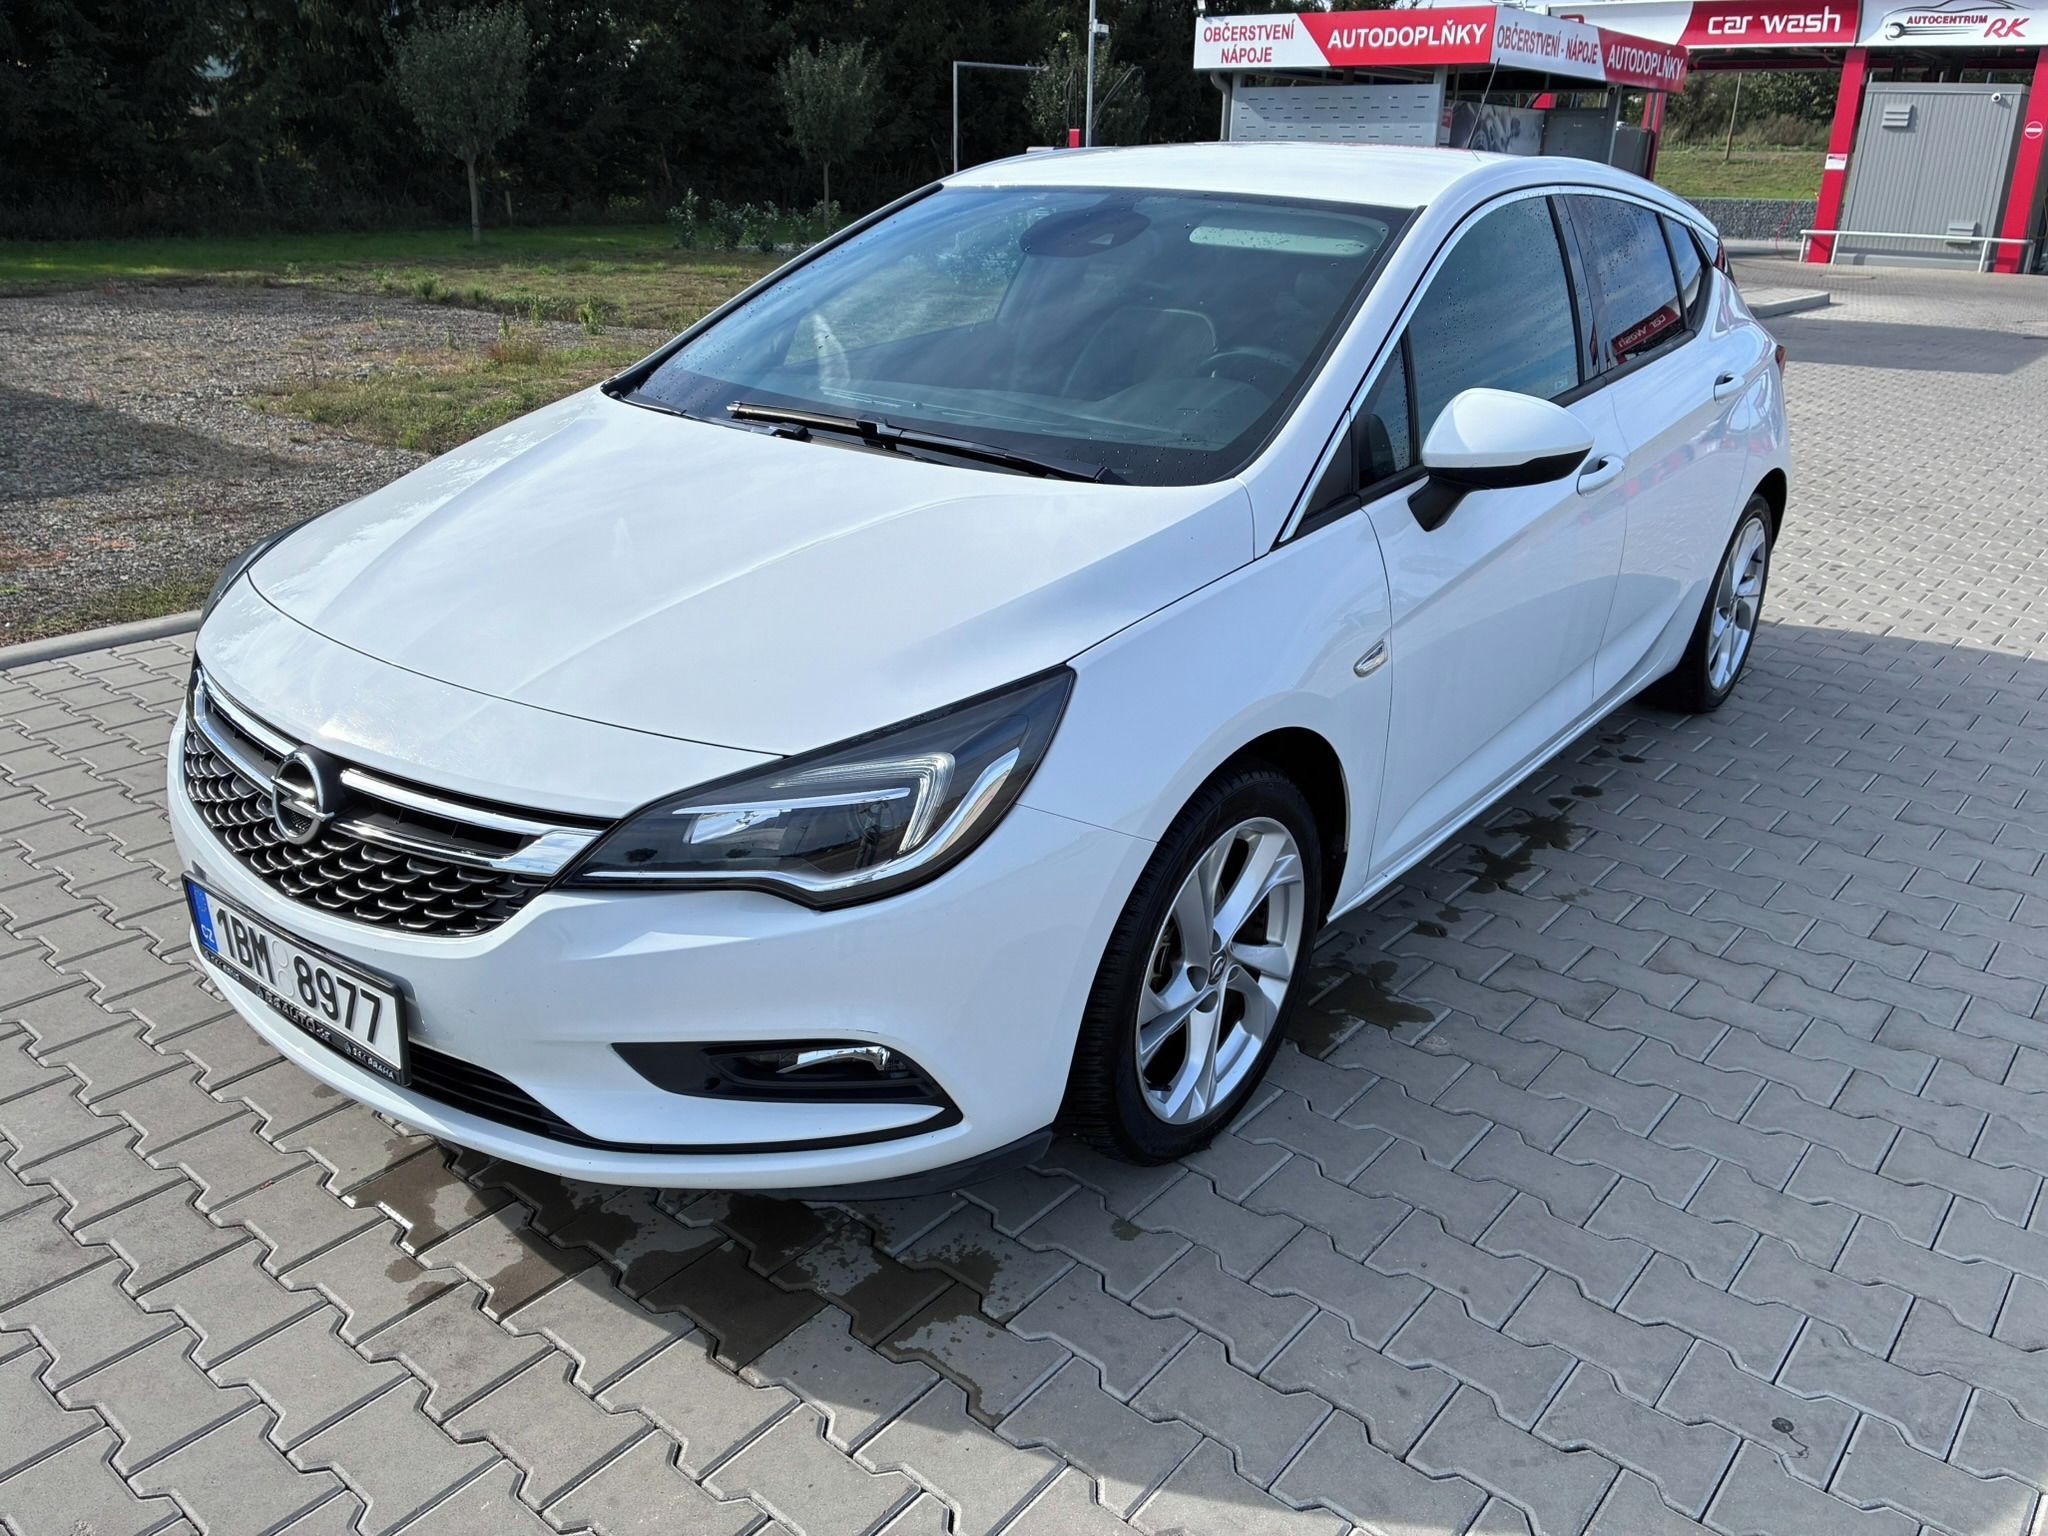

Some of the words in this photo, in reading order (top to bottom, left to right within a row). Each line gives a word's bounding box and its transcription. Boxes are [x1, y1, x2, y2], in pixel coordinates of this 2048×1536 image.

[1203, 19, 1295, 43] OBČERSTVENÍ
[1327, 19, 1488, 49] AUTODOPLŇKY
[1707, 15, 1753, 35] car
[1760, 5, 1841, 33] wash
[1906, 15, 1988, 25] AUTOCENTRUM
[1983, 17, 2030, 39] RK
[1220, 44, 1273, 64] NÁPOJE
[1496, 21, 1562, 58] OBČERSTVENÍ
[1565, 33, 1599, 65] NÁPOJE
[1606, 43, 1684, 81] AUTODOPLŇKY
[200, 924, 215, 944] CZ
[216, 907, 276, 985] 1BM
[293, 955, 381, 1045] 8977
